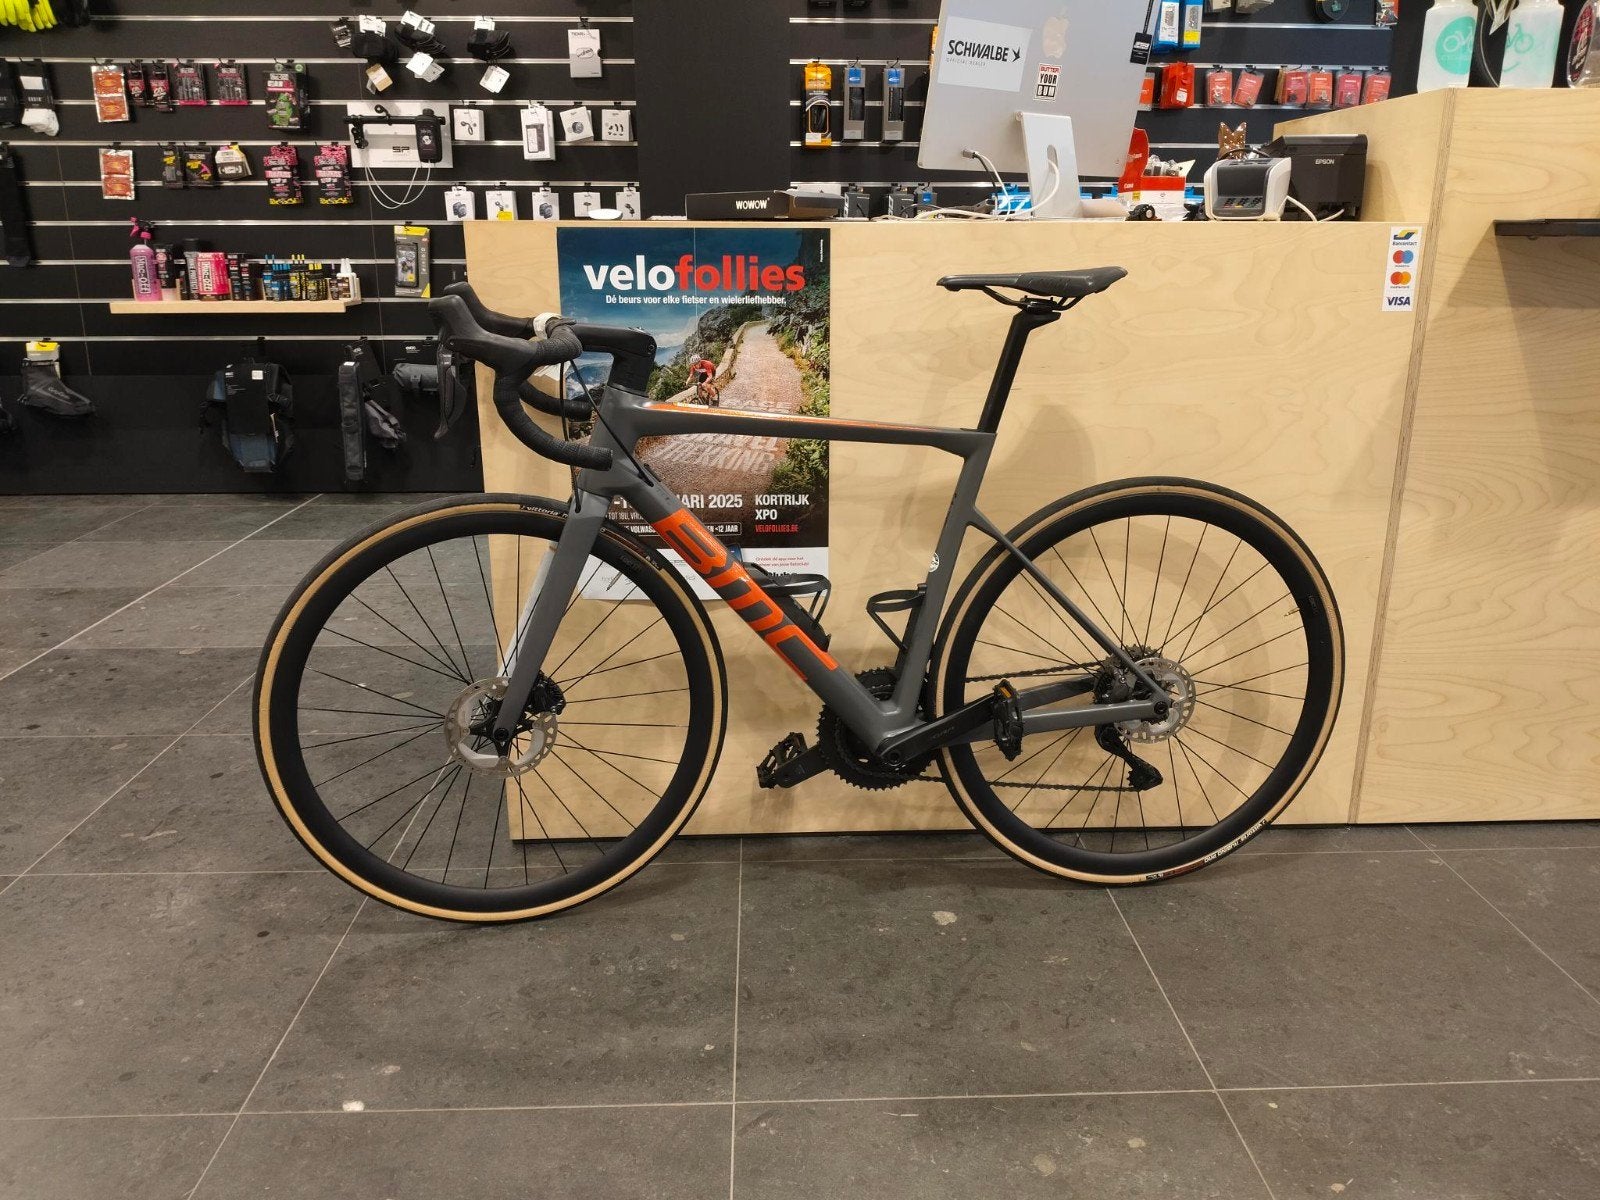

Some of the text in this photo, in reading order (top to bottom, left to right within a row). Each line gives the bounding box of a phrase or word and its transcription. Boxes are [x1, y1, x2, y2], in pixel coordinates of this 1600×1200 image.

[947, 39, 1009, 62] SCHWALBE
[1040, 73, 1057, 84] YOUR
[735, 199, 767, 210] WOWOW
[583, 254, 806, 292] velofollies
[605, 294, 617, 304] Dé
[618, 294, 641, 304] beurs
[643, 296, 661, 304] voor
[663, 295, 680, 304] elke
[682, 295, 707, 304] fietser
[721, 295, 787, 305] wielerliefhebber.
[1387, 296, 1411, 306] VISA
[708, 494, 743, 508] 2025
[755, 494, 810, 506] KORTRIJK
[755, 509, 778, 520] XPO
[630, 525, 657, 534] VOLWAS
[652, 507, 839, 681] BMC
